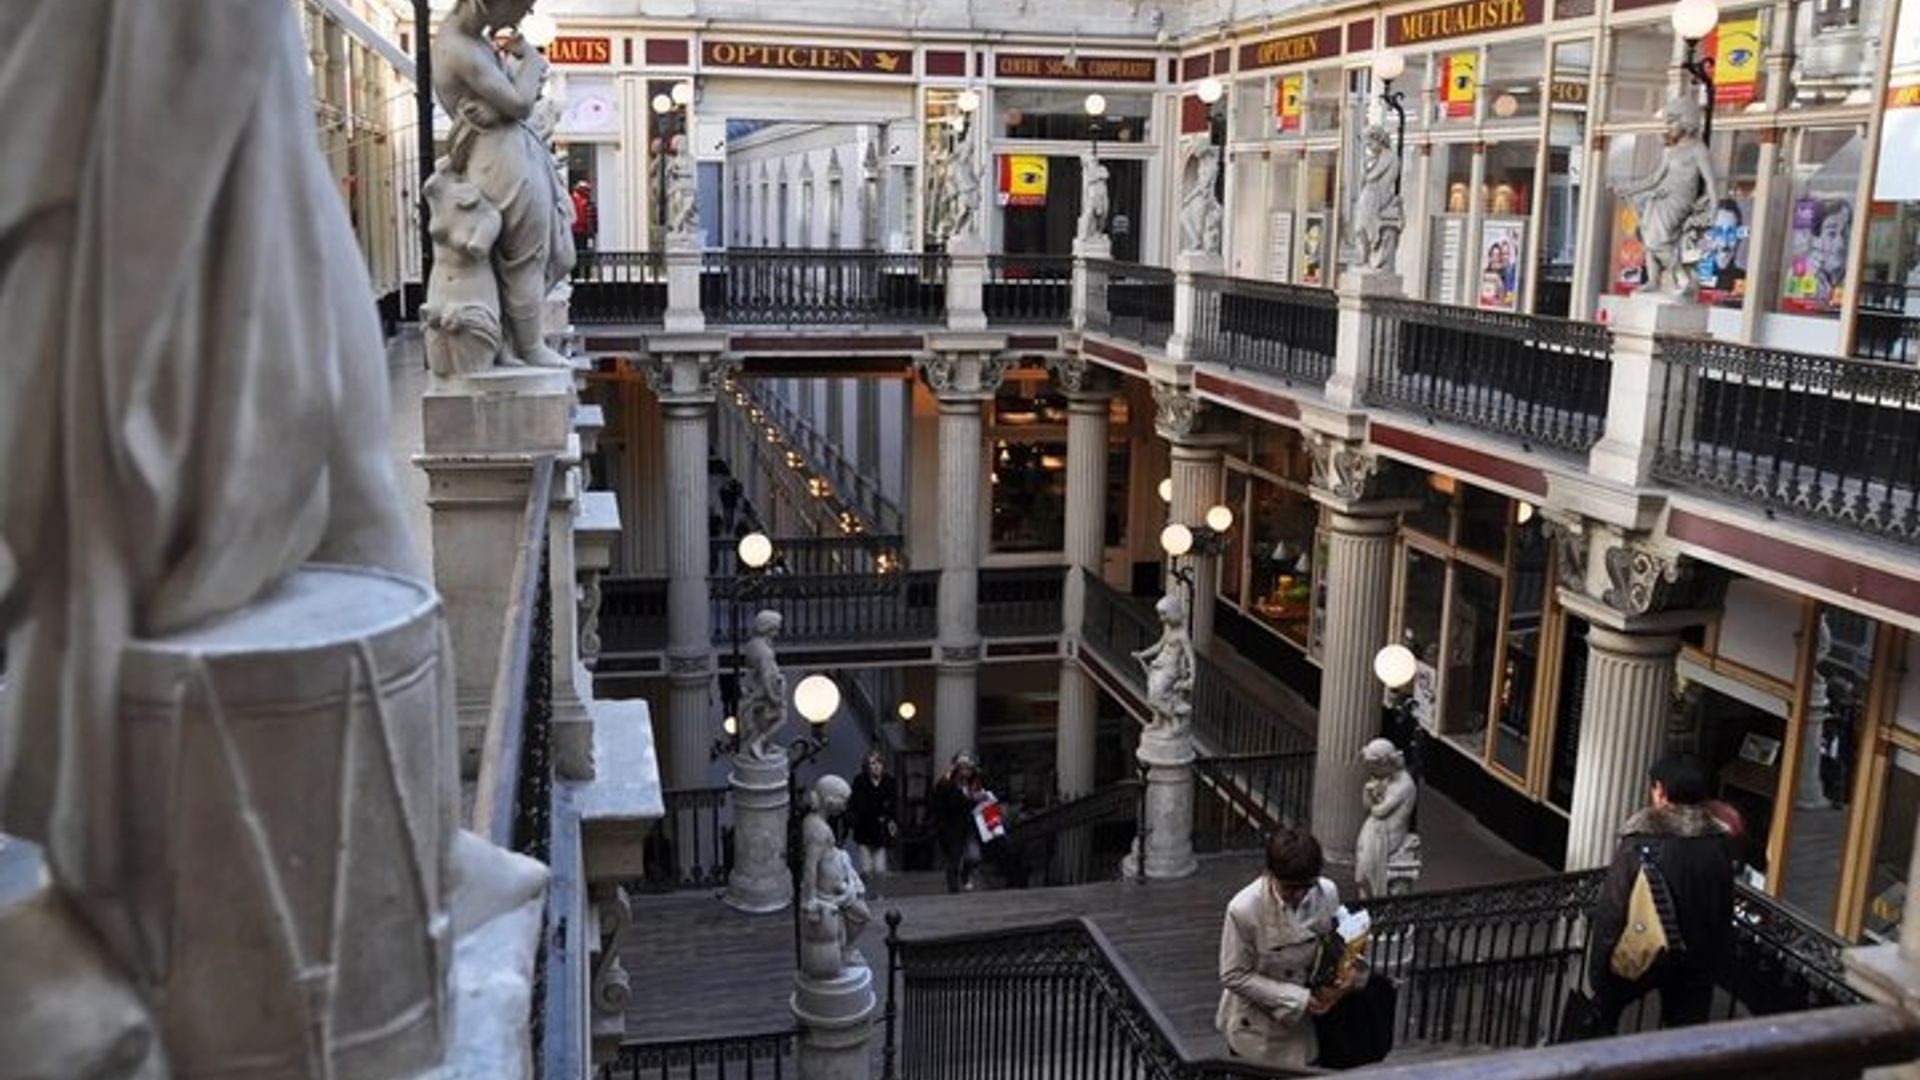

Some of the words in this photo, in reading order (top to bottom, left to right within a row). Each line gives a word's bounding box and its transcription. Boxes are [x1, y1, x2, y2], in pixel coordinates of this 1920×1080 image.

[1400, 0, 1525, 42] MUTUALISTE
[711, 43, 863, 69] OPTICIEN
[1257, 34, 1319, 64] OPTICIEN
